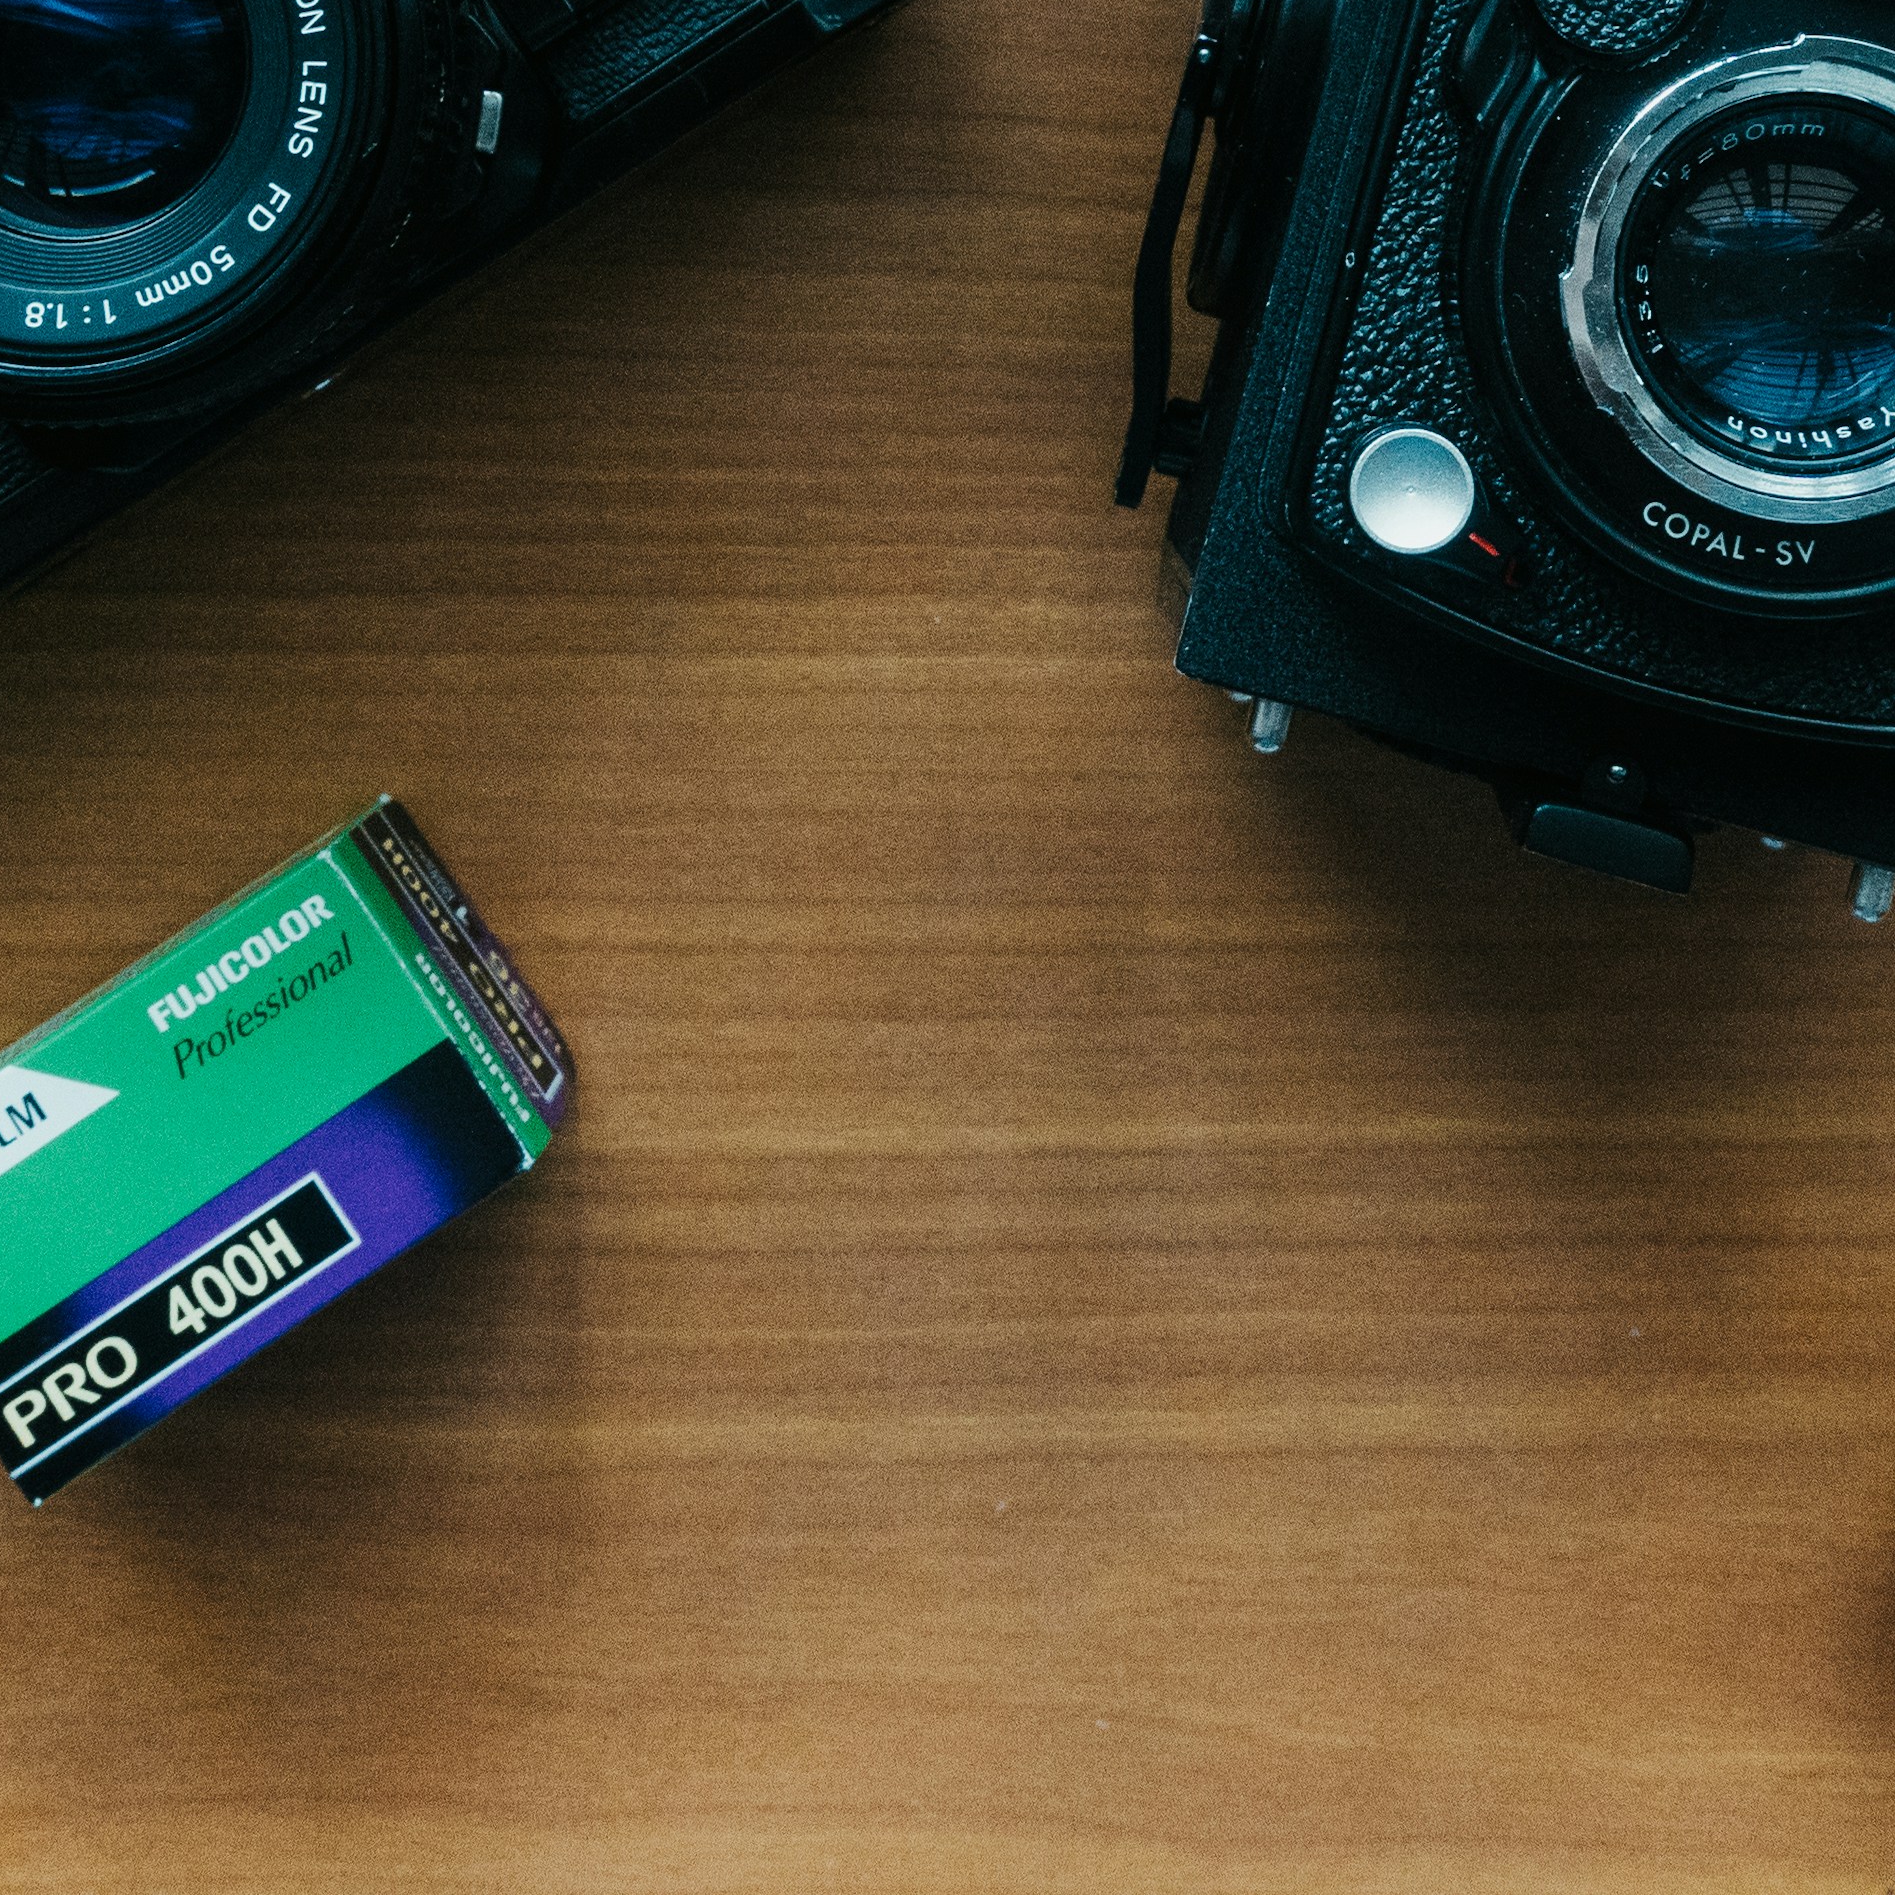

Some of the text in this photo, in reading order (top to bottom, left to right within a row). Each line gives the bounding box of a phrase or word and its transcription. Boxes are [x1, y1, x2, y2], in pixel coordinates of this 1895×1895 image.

[288, 61, 328, 158] LENS
[247, 182, 292, 232] FD
[135, 244, 236, 307] 50mm
[147, 892, 335, 1034] FUJICOLOR
[170, 932, 354, 1081] Professional
[2, 1217, 303, 1449] PRO 400H
